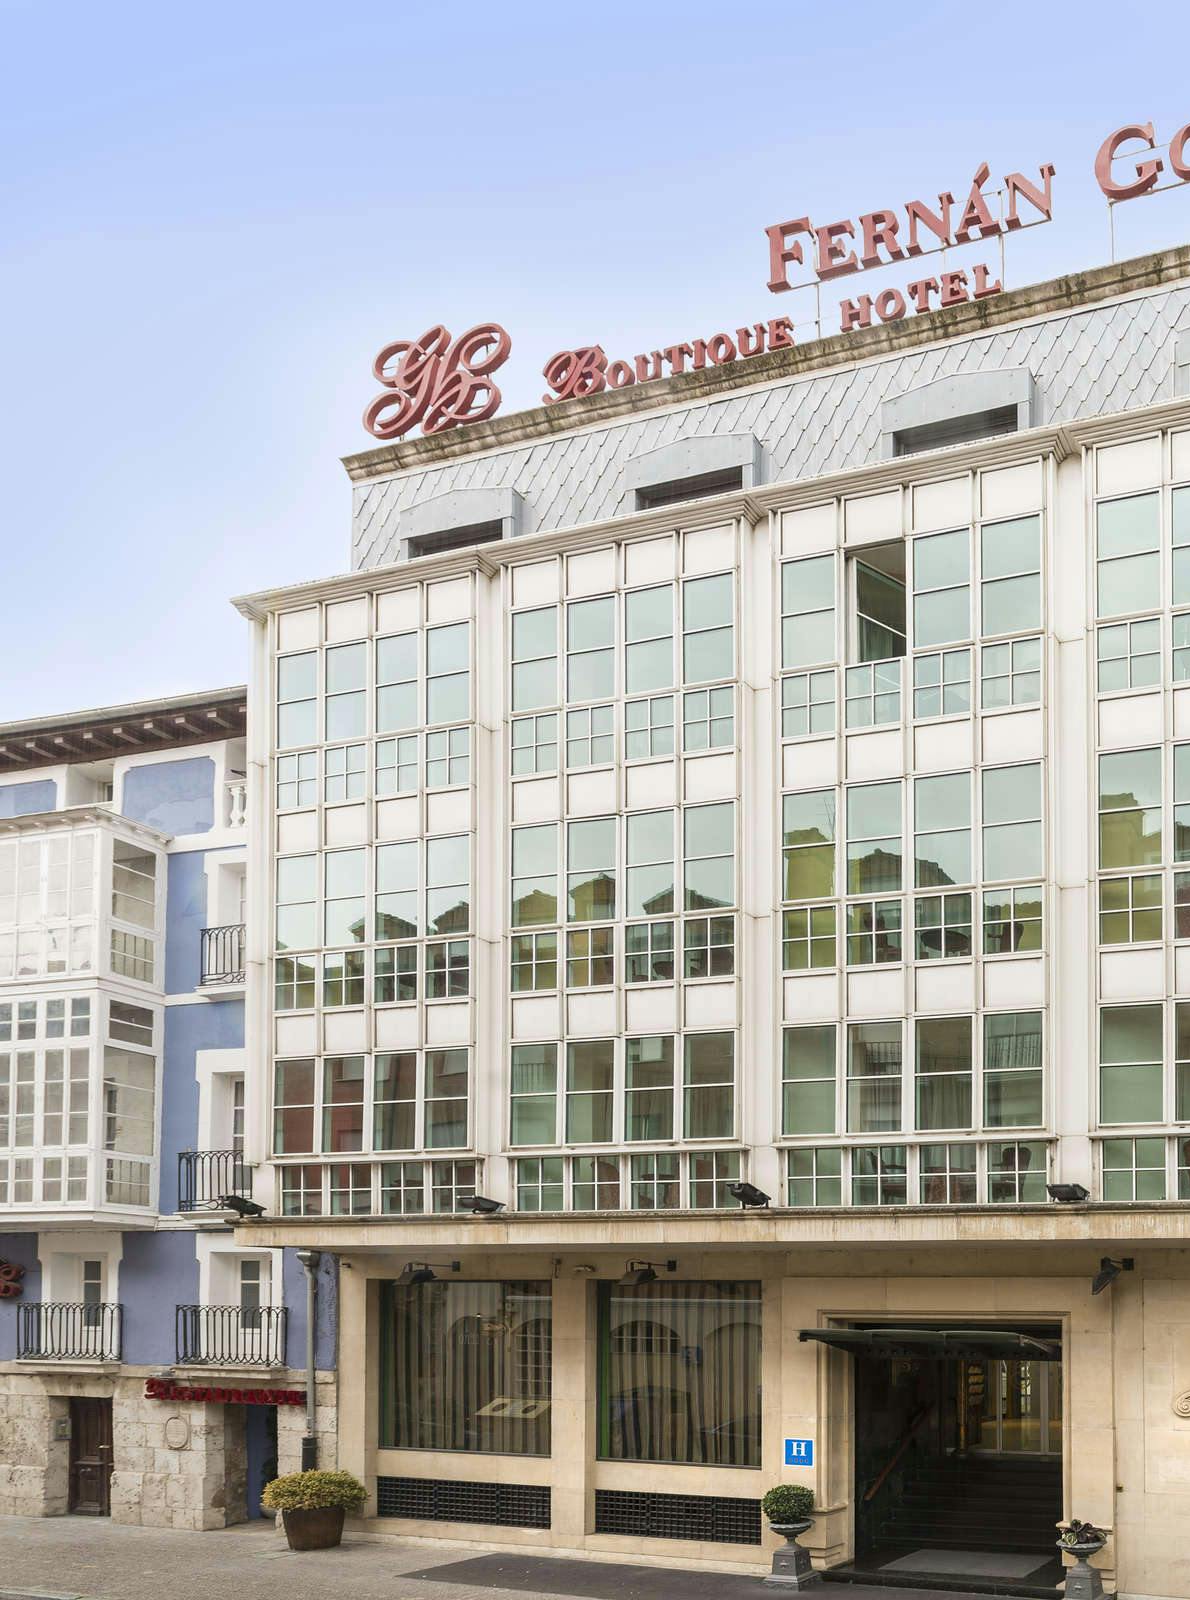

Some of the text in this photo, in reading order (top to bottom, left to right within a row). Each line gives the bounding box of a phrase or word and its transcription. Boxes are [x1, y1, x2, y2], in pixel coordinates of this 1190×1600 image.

[765, 162, 1056, 294] FERNÁN
[542, 264, 1003, 405] BOUTIQUE HOTEL
[792, 1441, 807, 1457] H
